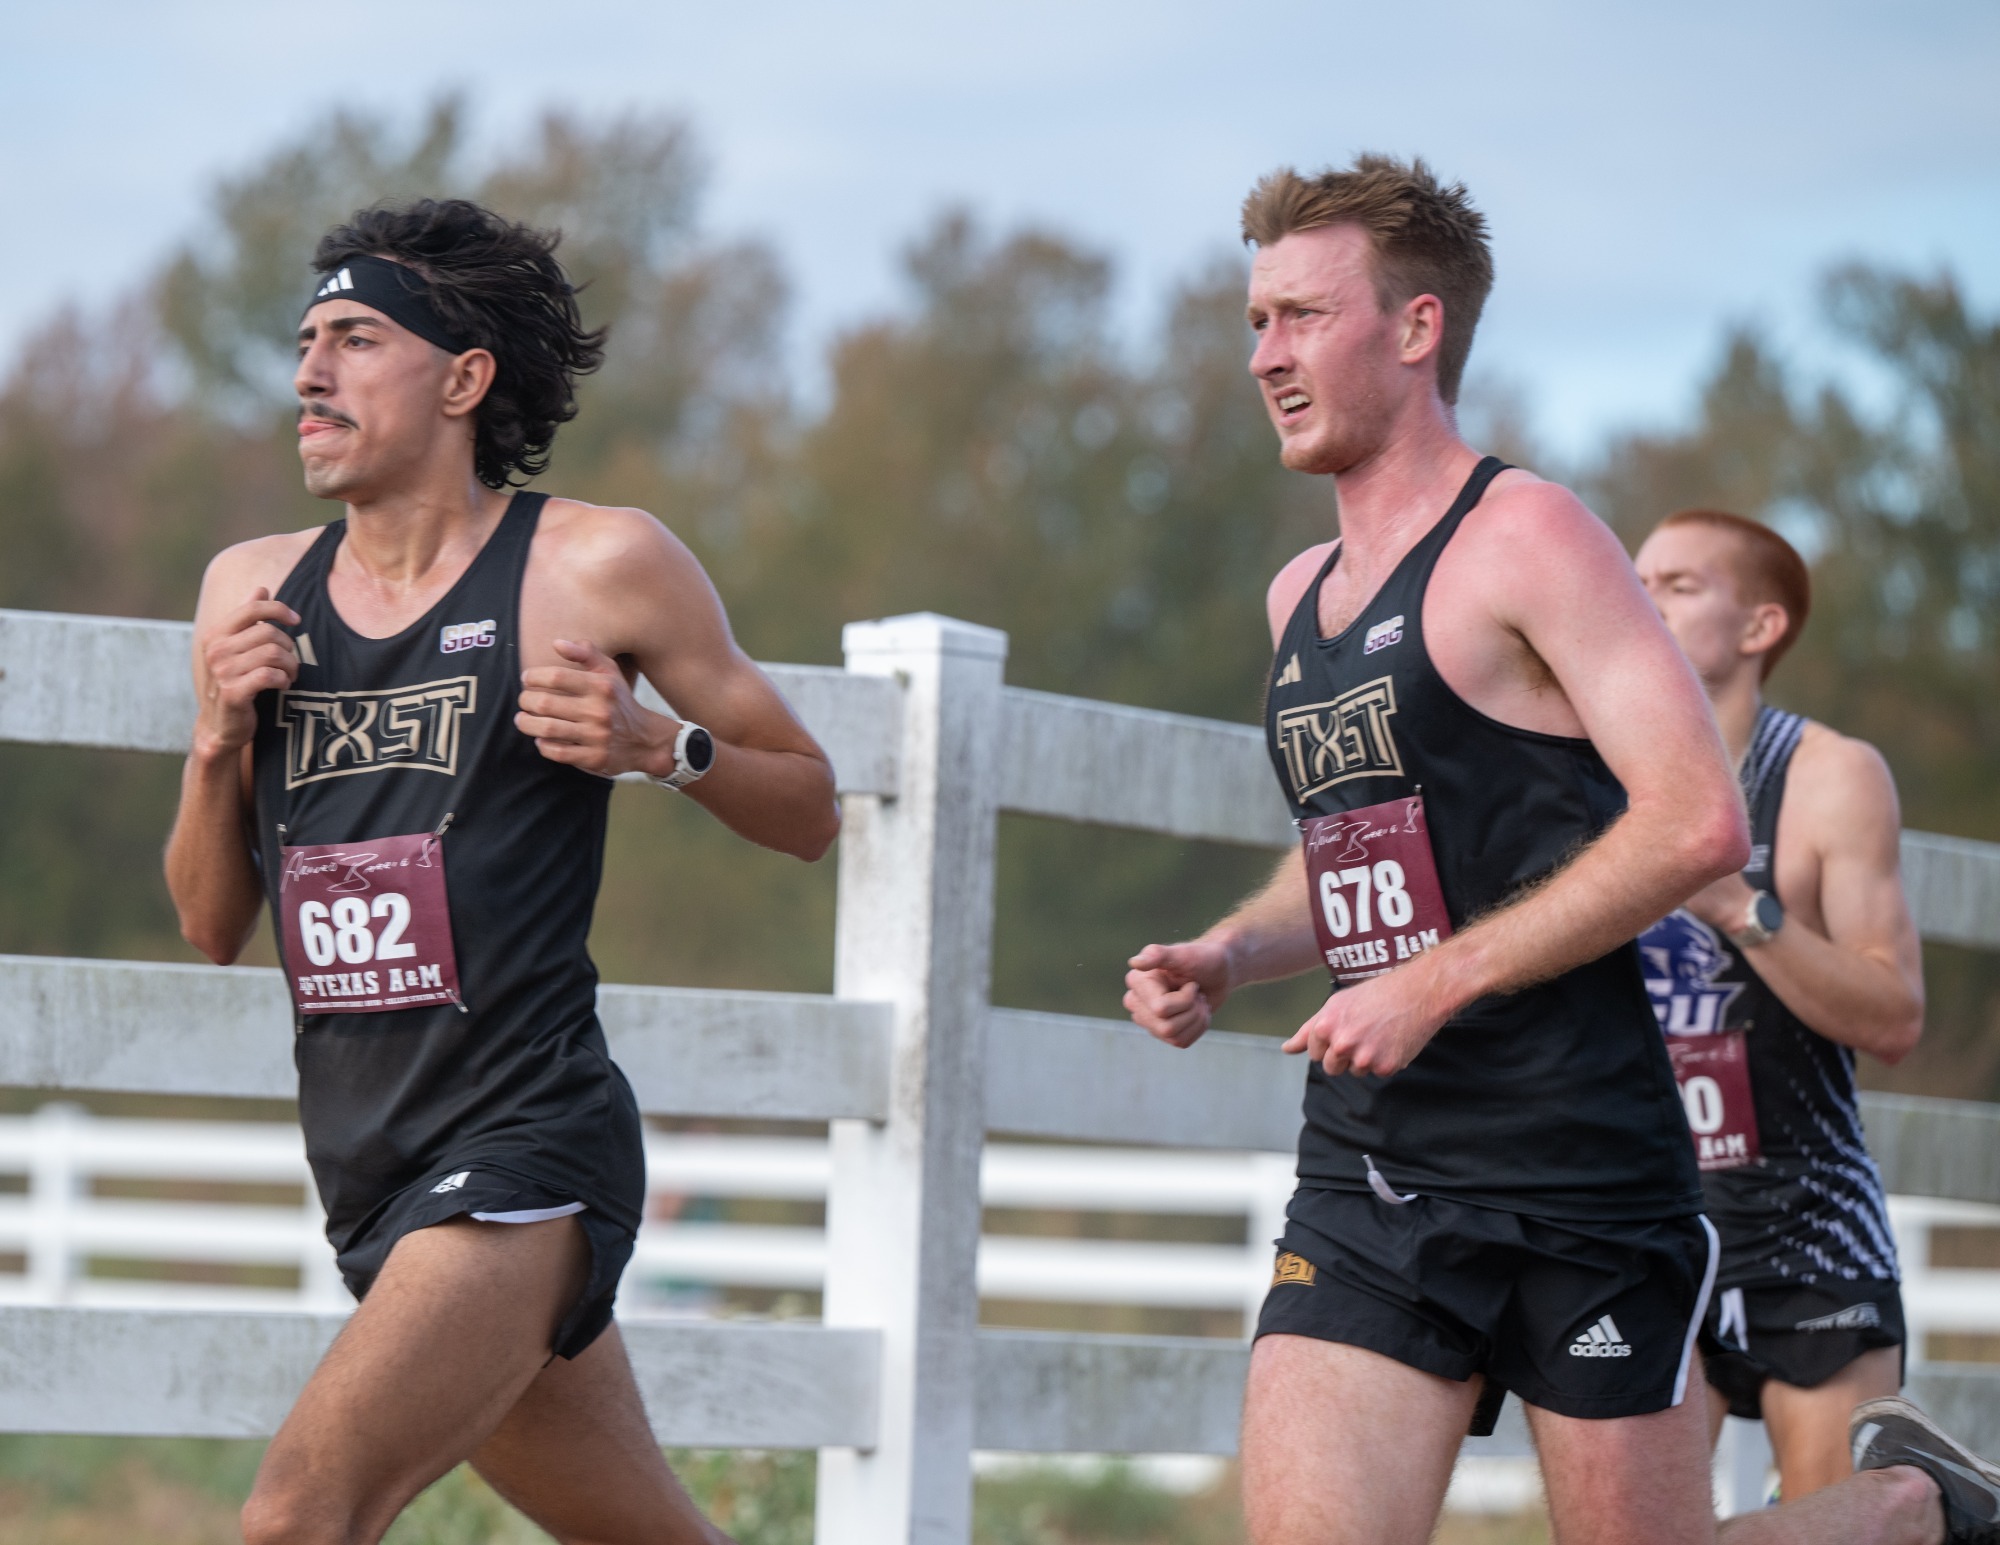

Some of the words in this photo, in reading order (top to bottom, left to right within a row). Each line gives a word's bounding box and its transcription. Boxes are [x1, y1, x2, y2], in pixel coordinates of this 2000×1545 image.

[441, 619, 496, 653] SBC
[284, 684, 469, 779] TXST
[1279, 685, 1396, 795] TXST
[1319, 859, 1414, 938] 678
[299, 892, 417, 967] 682
[1335, 938, 1390, 969] TEXAS
[1394, 928, 1440, 961] A&M
[311, 970, 381, 998] TEXAS
[388, 963, 444, 993] A&M
[1676, 1075, 1724, 1135] 0
[1568, 1341, 1633, 1358] adidas
